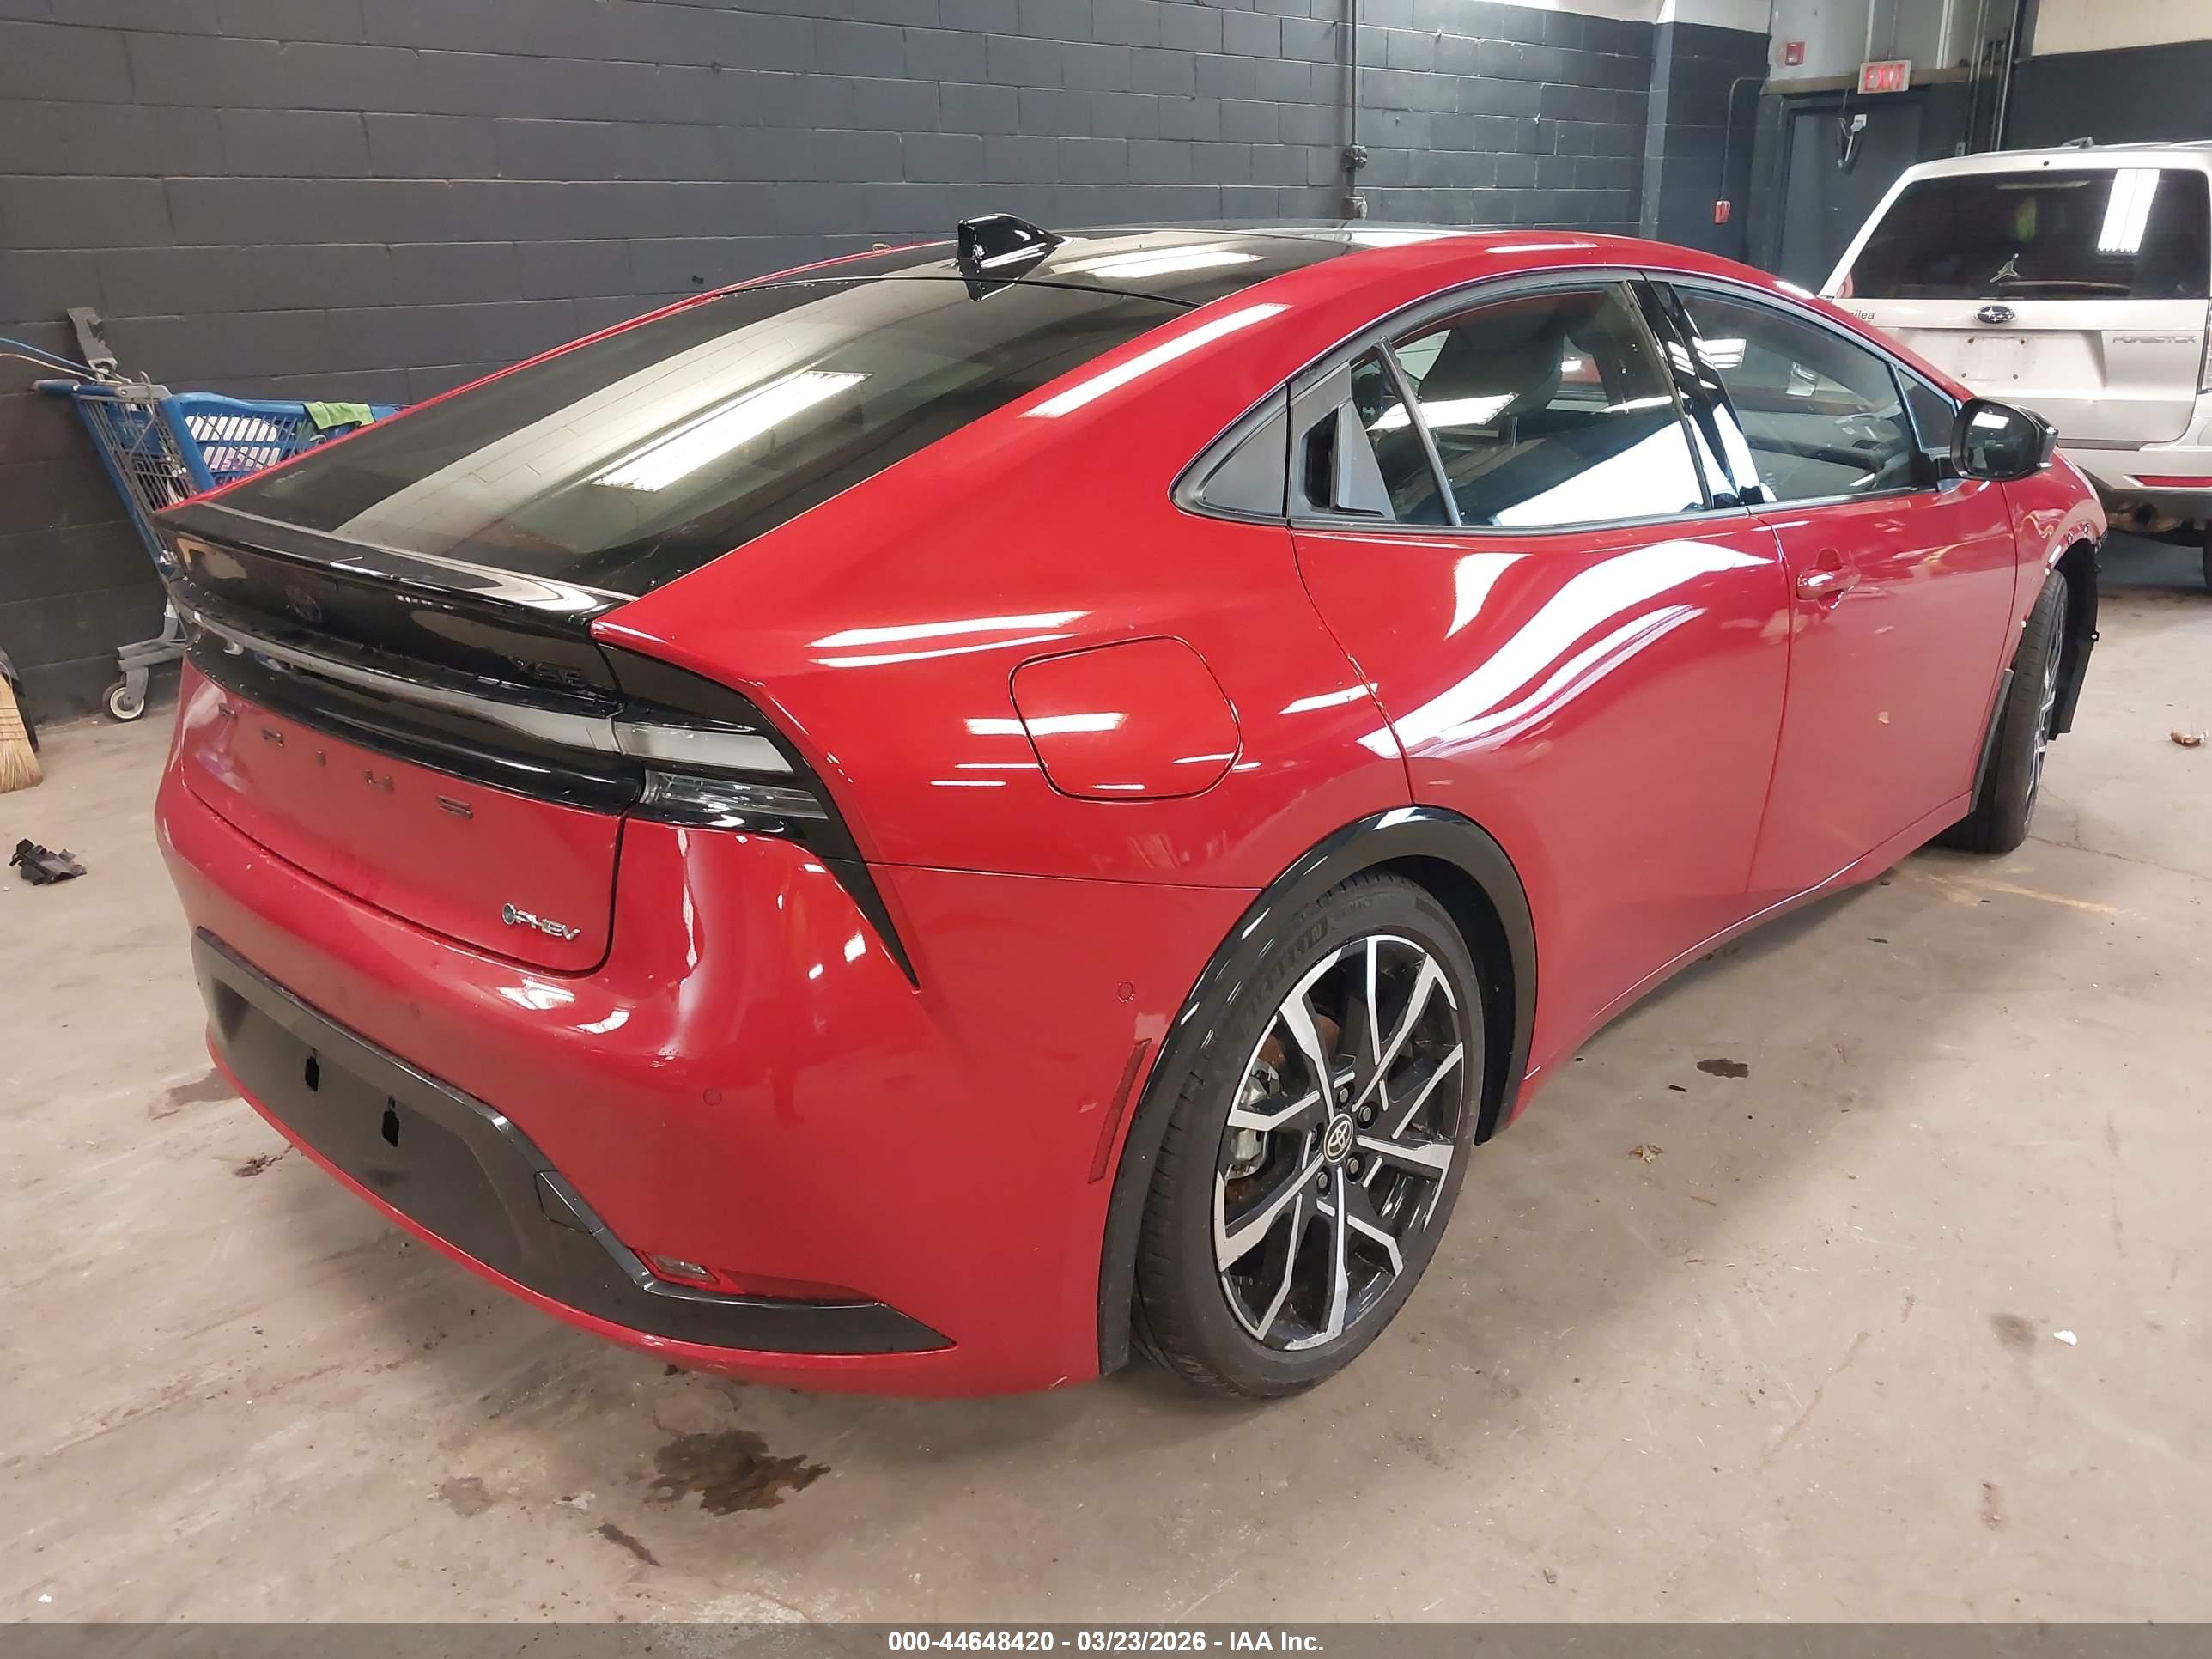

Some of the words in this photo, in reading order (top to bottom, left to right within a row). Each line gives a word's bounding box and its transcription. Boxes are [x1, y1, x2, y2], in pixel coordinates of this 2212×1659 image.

[1864, 64, 1905, 91] EXIT
[1850, 309, 1875, 319] ilea
[515, 910, 581, 941] PHEV
